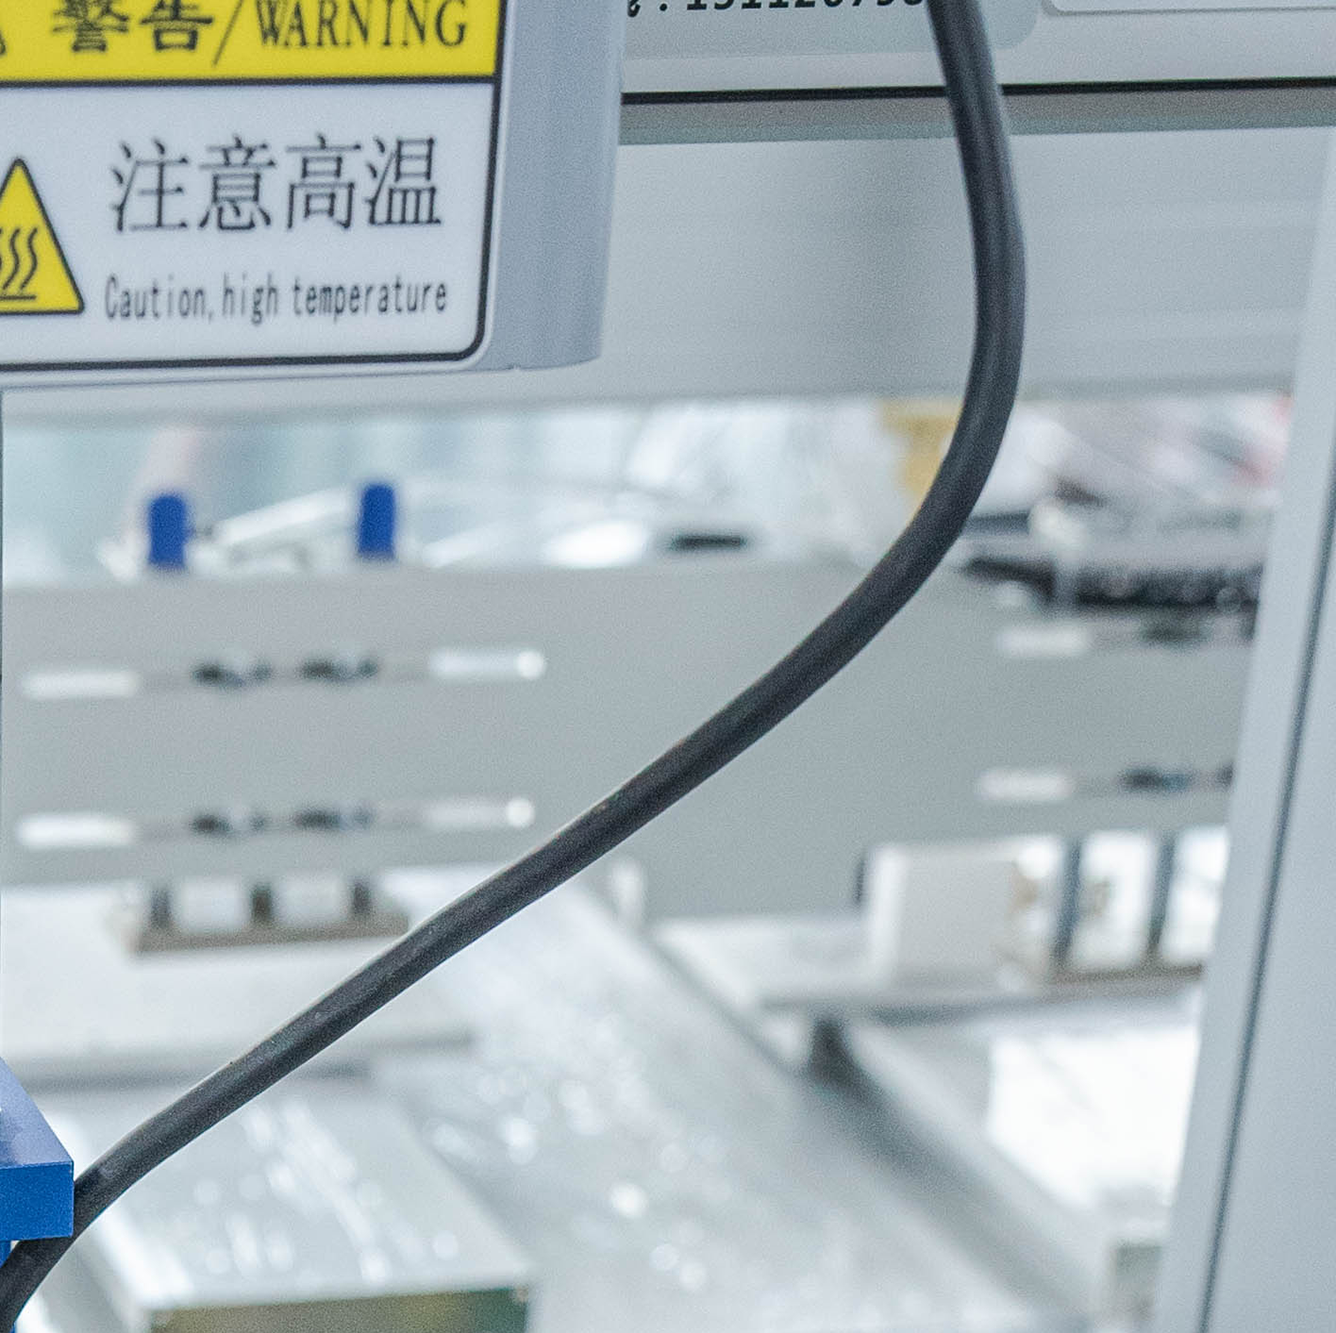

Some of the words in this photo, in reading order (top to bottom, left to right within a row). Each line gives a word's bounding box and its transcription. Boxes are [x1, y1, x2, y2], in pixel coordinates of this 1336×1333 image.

[110, 133, 442, 233] 注意高温
[293, 273, 448, 324] temperature
